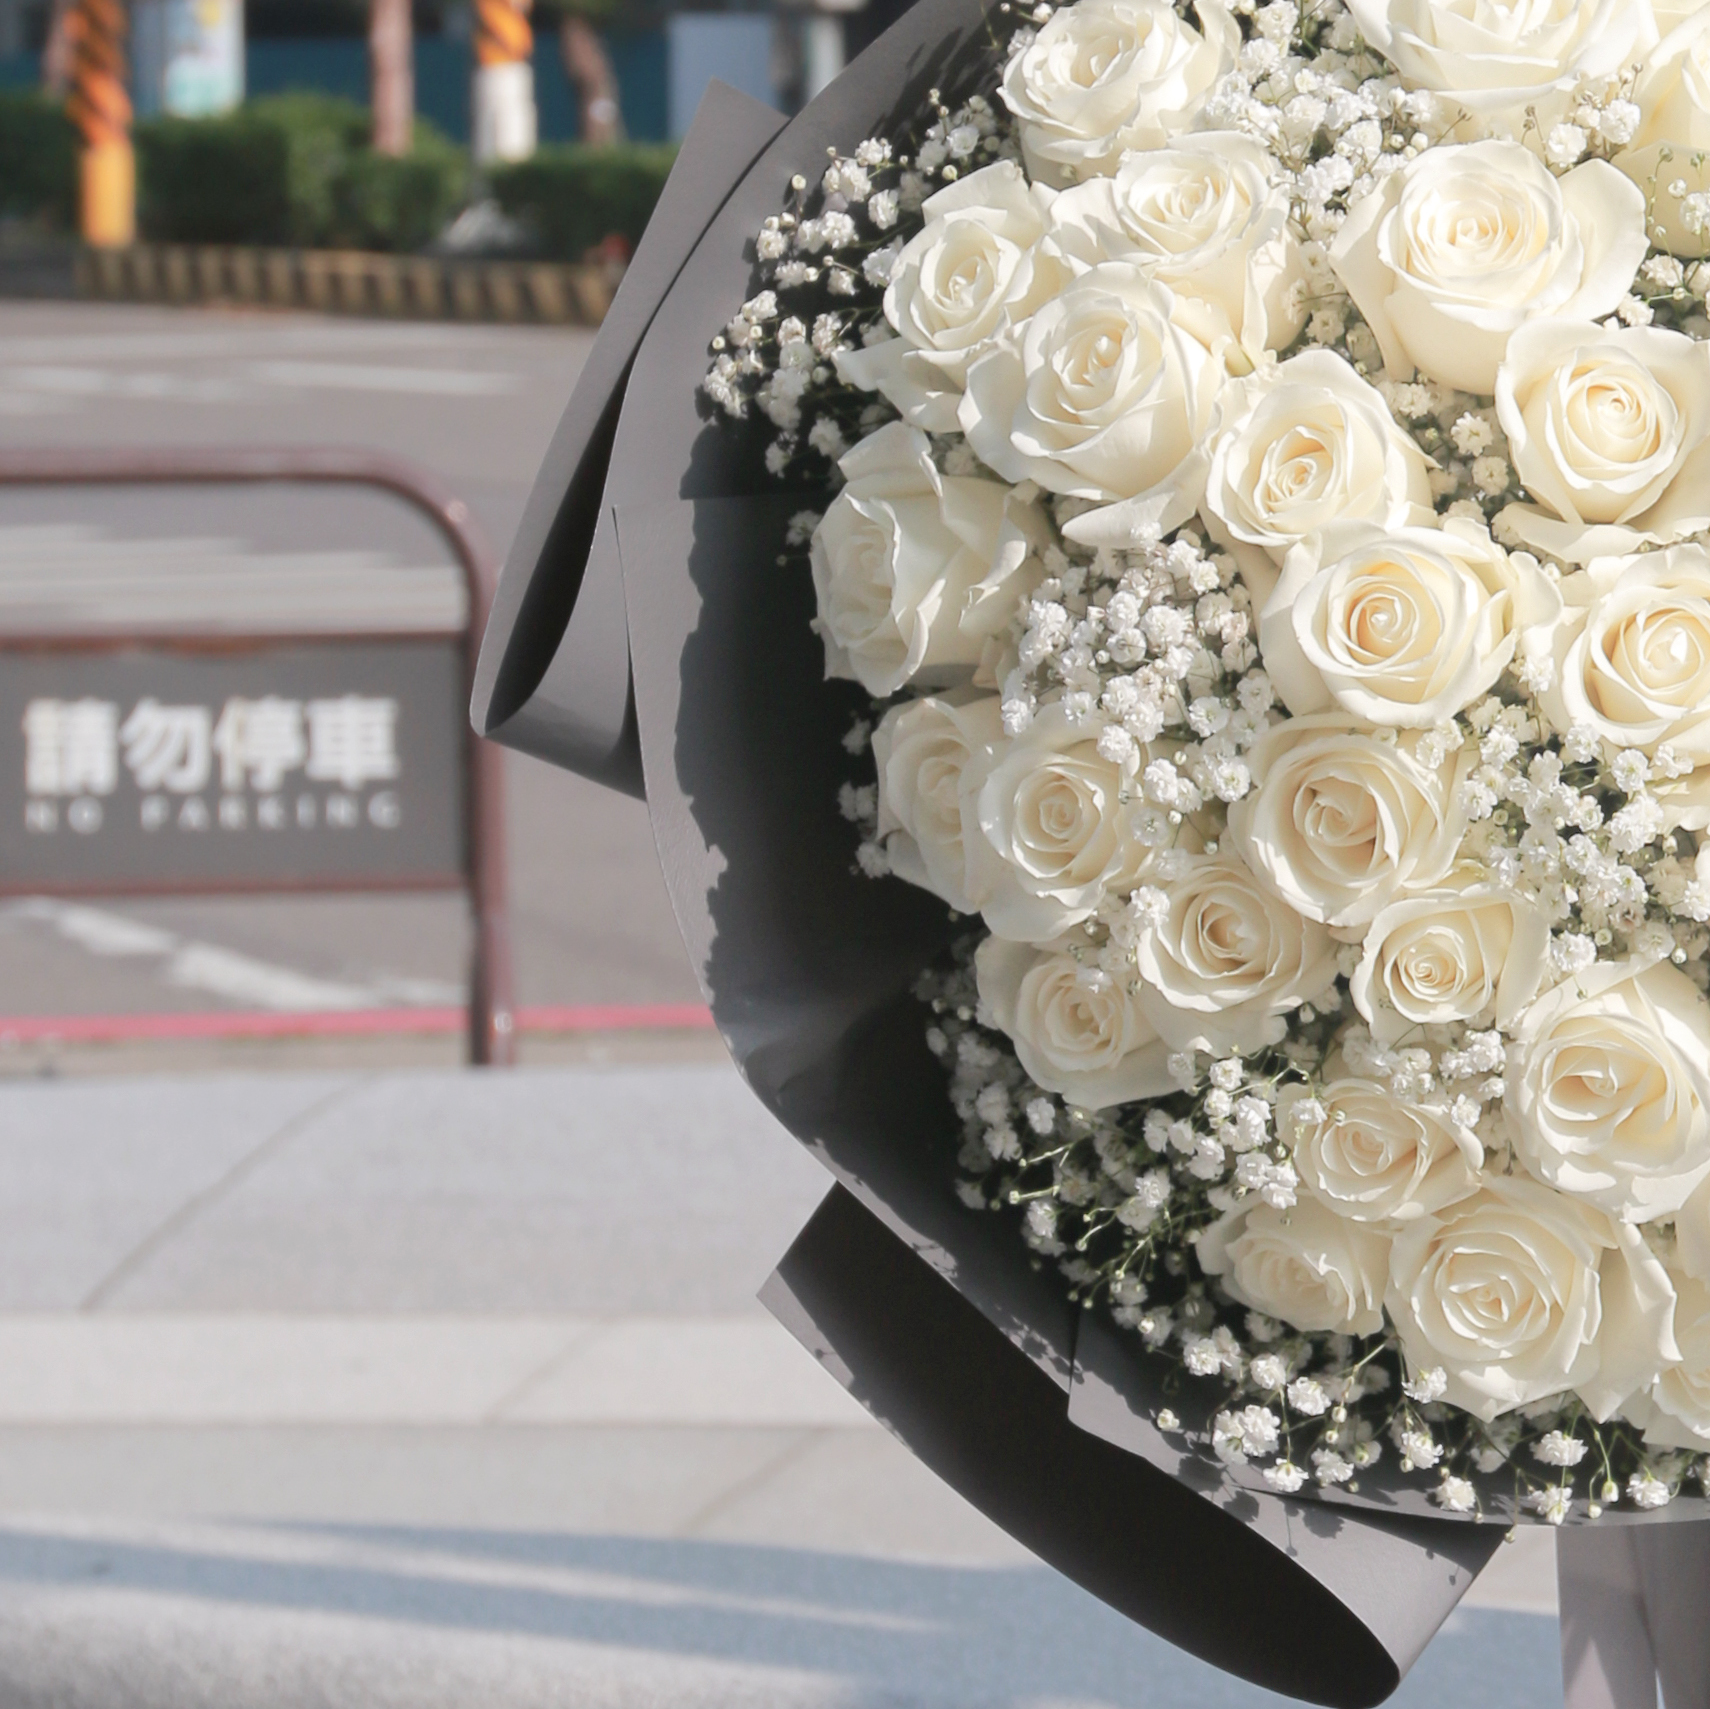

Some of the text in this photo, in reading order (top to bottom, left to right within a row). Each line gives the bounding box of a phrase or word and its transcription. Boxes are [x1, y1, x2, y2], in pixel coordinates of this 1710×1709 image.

[23, 695, 397, 795] 請勿停車
[25, 791, 400, 834] NO PARKING
